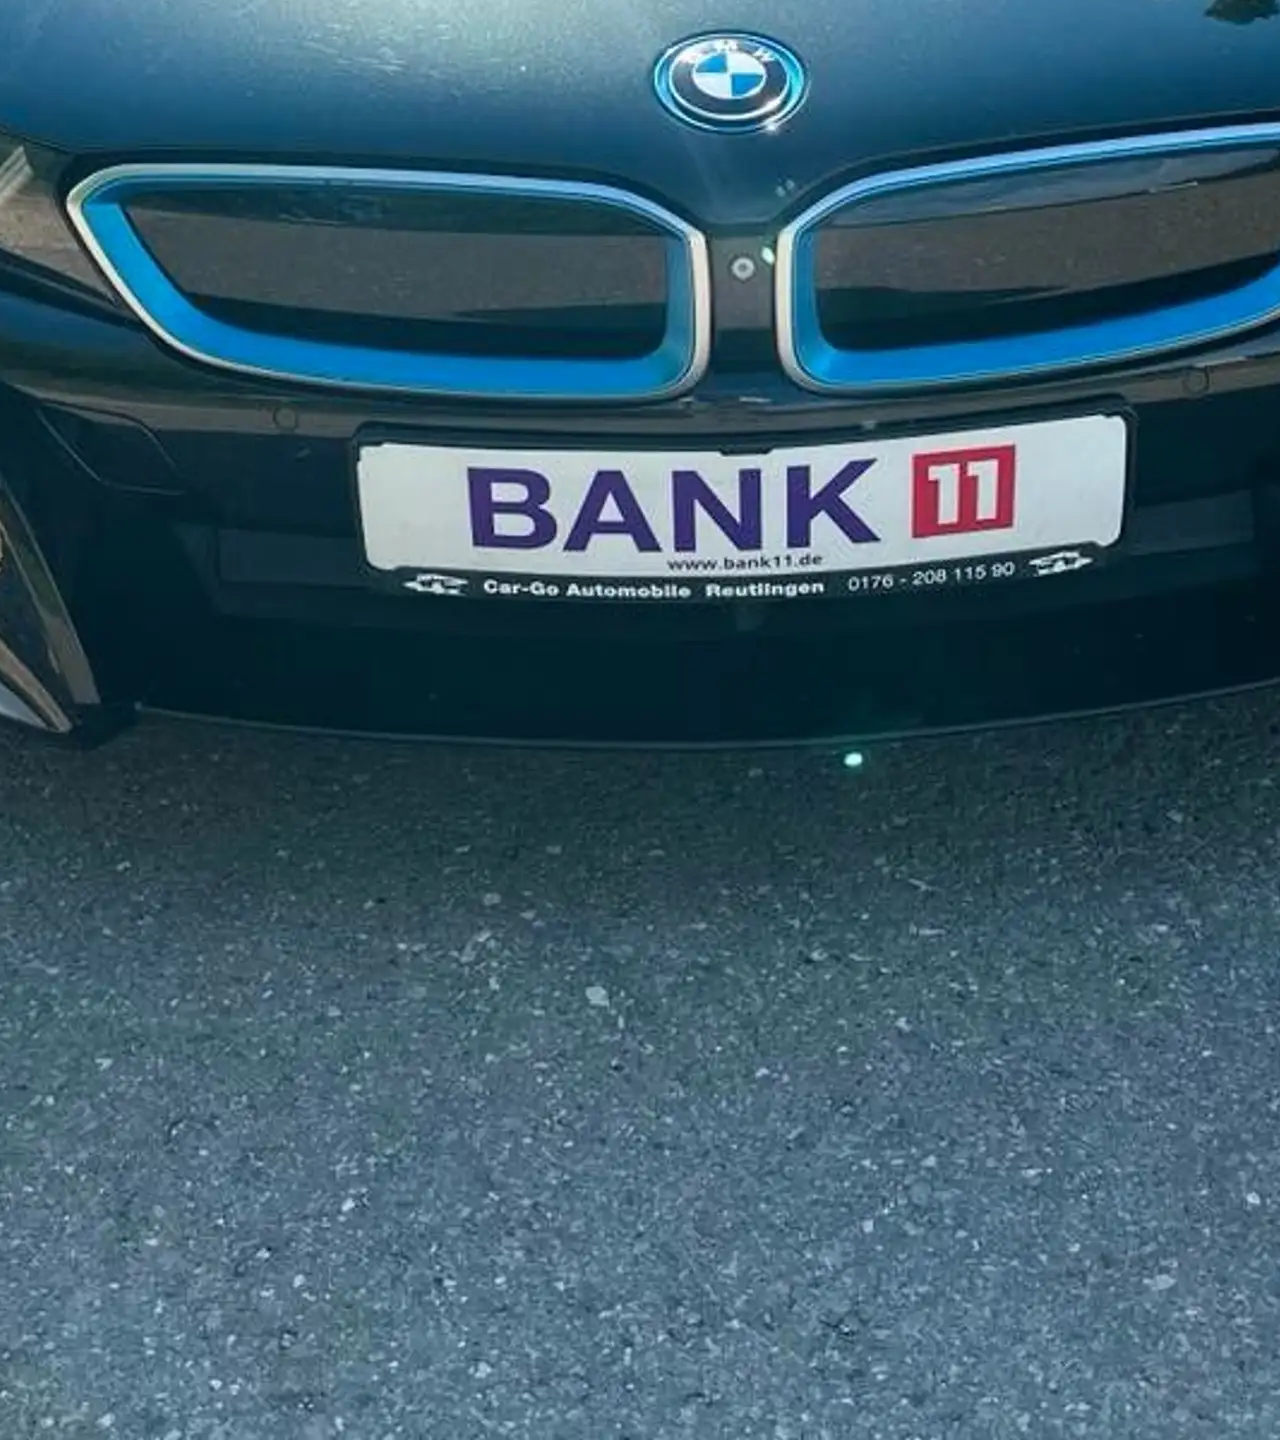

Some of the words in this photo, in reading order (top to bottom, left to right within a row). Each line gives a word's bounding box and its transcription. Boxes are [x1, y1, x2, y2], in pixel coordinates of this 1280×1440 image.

[467, 458, 881, 553] BANK
[928, 461, 1000, 526] 11
[666, 553, 824, 572] www.bank11.de
[483, 579, 559, 597] Car-Go
[566, 581, 692, 599] Automobile
[705, 580, 825, 598] Reutlingen
[848, 574, 894, 591] 0176
[912, 570, 947, 586] 208
[954, 565, 987, 581] 115
